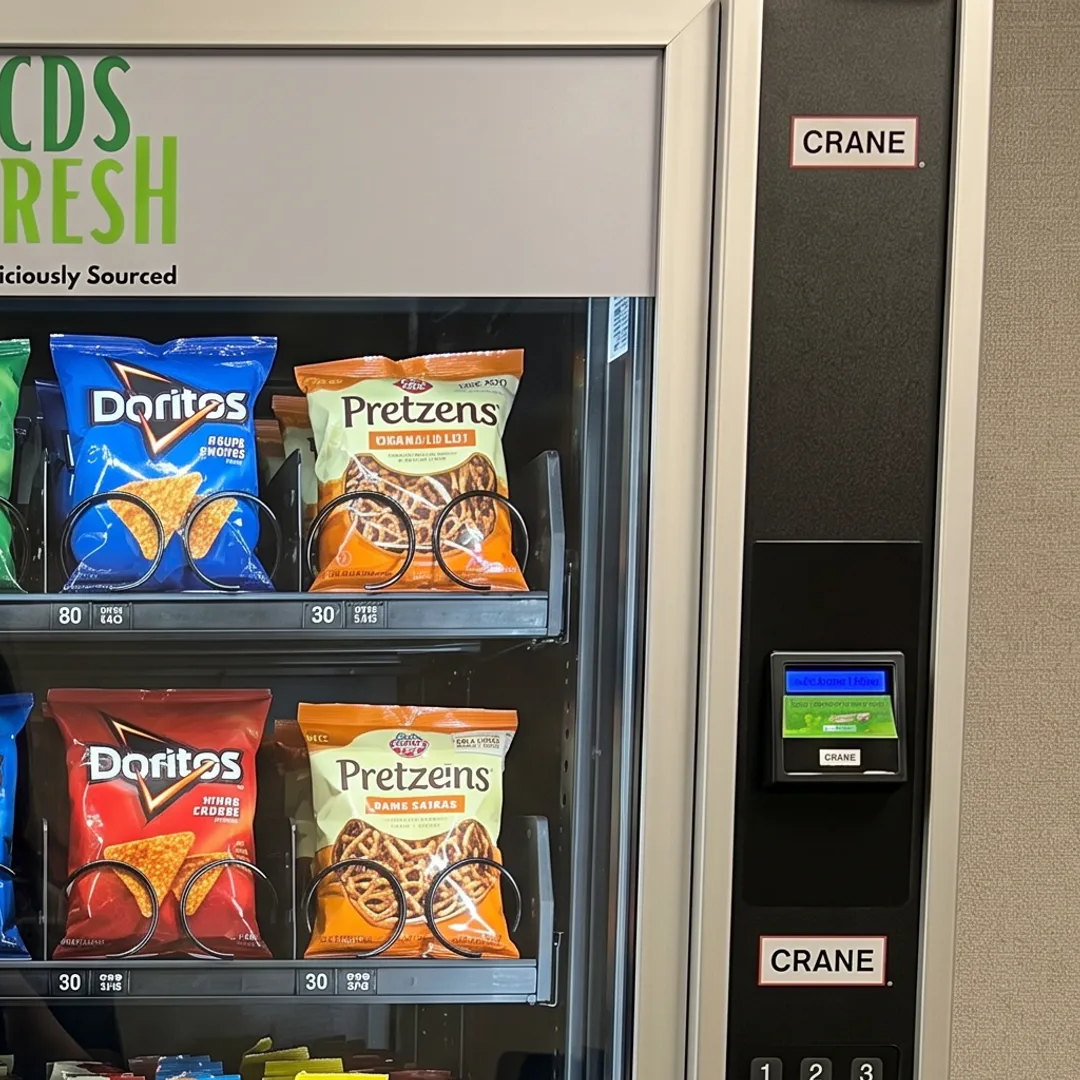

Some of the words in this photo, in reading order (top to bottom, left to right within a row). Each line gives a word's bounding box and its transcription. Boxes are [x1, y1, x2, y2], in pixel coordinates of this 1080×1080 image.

[803, 130, 905, 154] CRANE
[86, 264, 178, 286] Sourced
[93, 388, 248, 424] Doritos
[58, 606, 82, 625] 80
[311, 605, 336, 624] 30
[88, 746, 243, 782] Doritos
[824, 753, 857, 762] CRANE
[770, 948, 875, 972] CRANE
[58, 973, 82, 991] 30
[305, 973, 328, 991] 30
